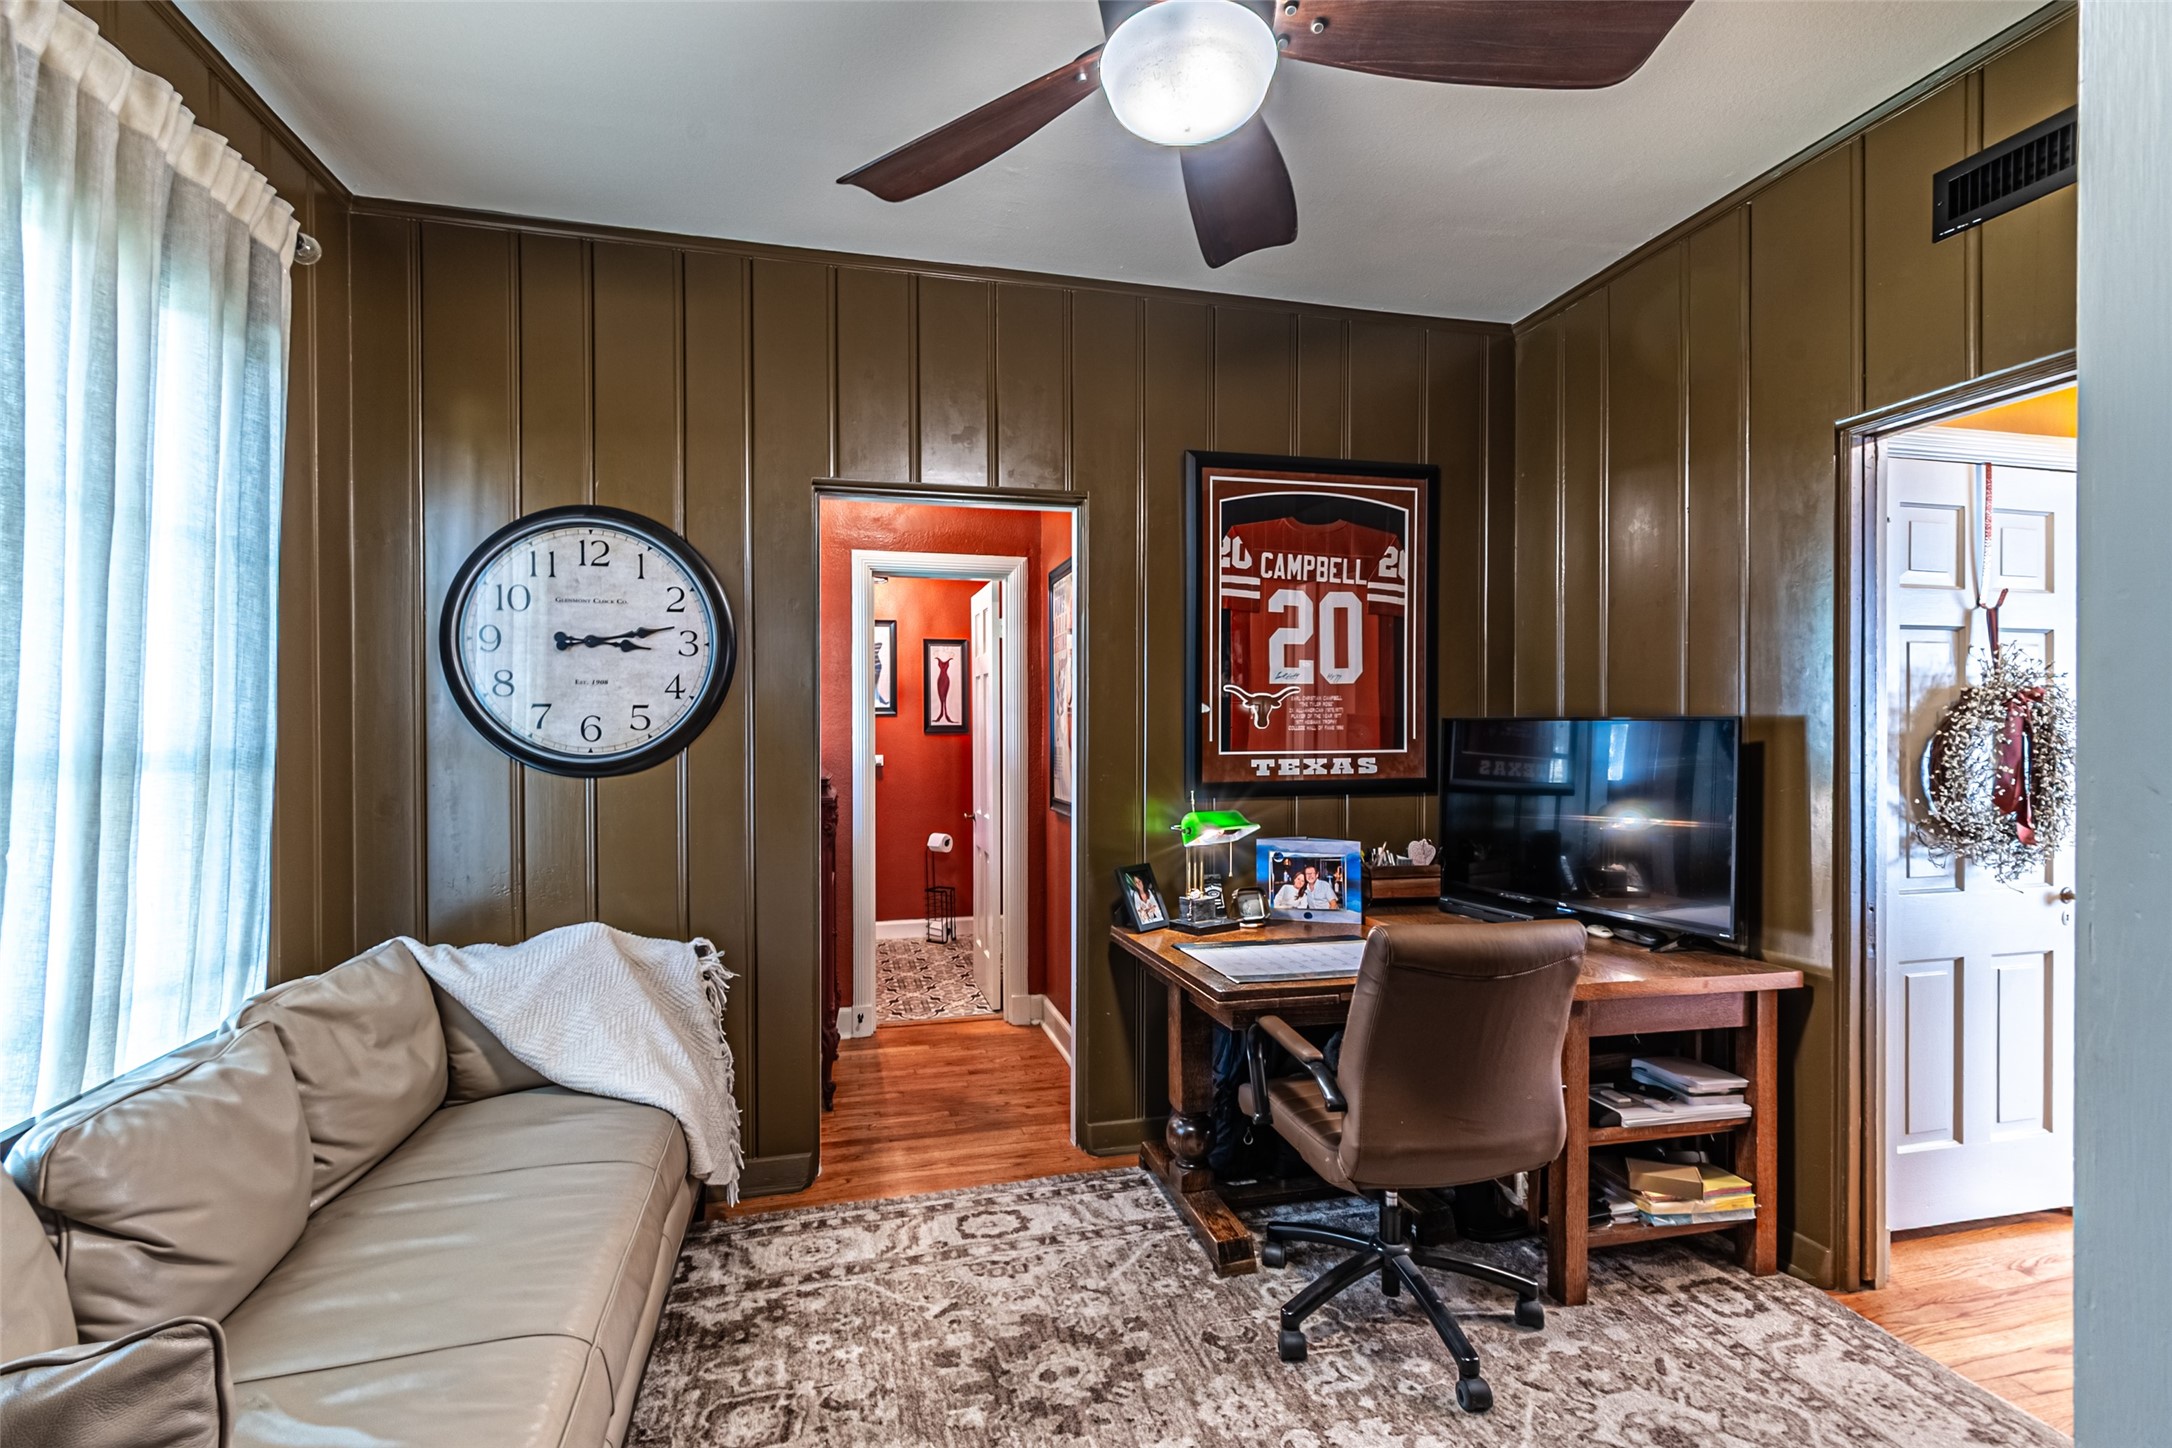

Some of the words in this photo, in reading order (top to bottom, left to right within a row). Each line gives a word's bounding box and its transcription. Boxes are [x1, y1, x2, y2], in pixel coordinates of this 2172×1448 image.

[530, 550, 556, 578] 11
[579, 539, 611, 567] 12
[638, 552, 646, 580] 1
[1260, 551, 1368, 585] CAMPBELL
[495, 583, 532, 612] 10
[666, 586, 686, 613] 2
[478, 623, 502, 652] 9
[677, 629, 699, 657] 3
[1268, 588, 1364, 685] 20
[492, 669, 515, 697] 8
[664, 674, 687, 700] 4
[531, 703, 552, 729] 7
[580, 715, 602, 742] 6
[630, 704, 651, 730] 5
[1250, 757, 1378, 776] TEXAS
